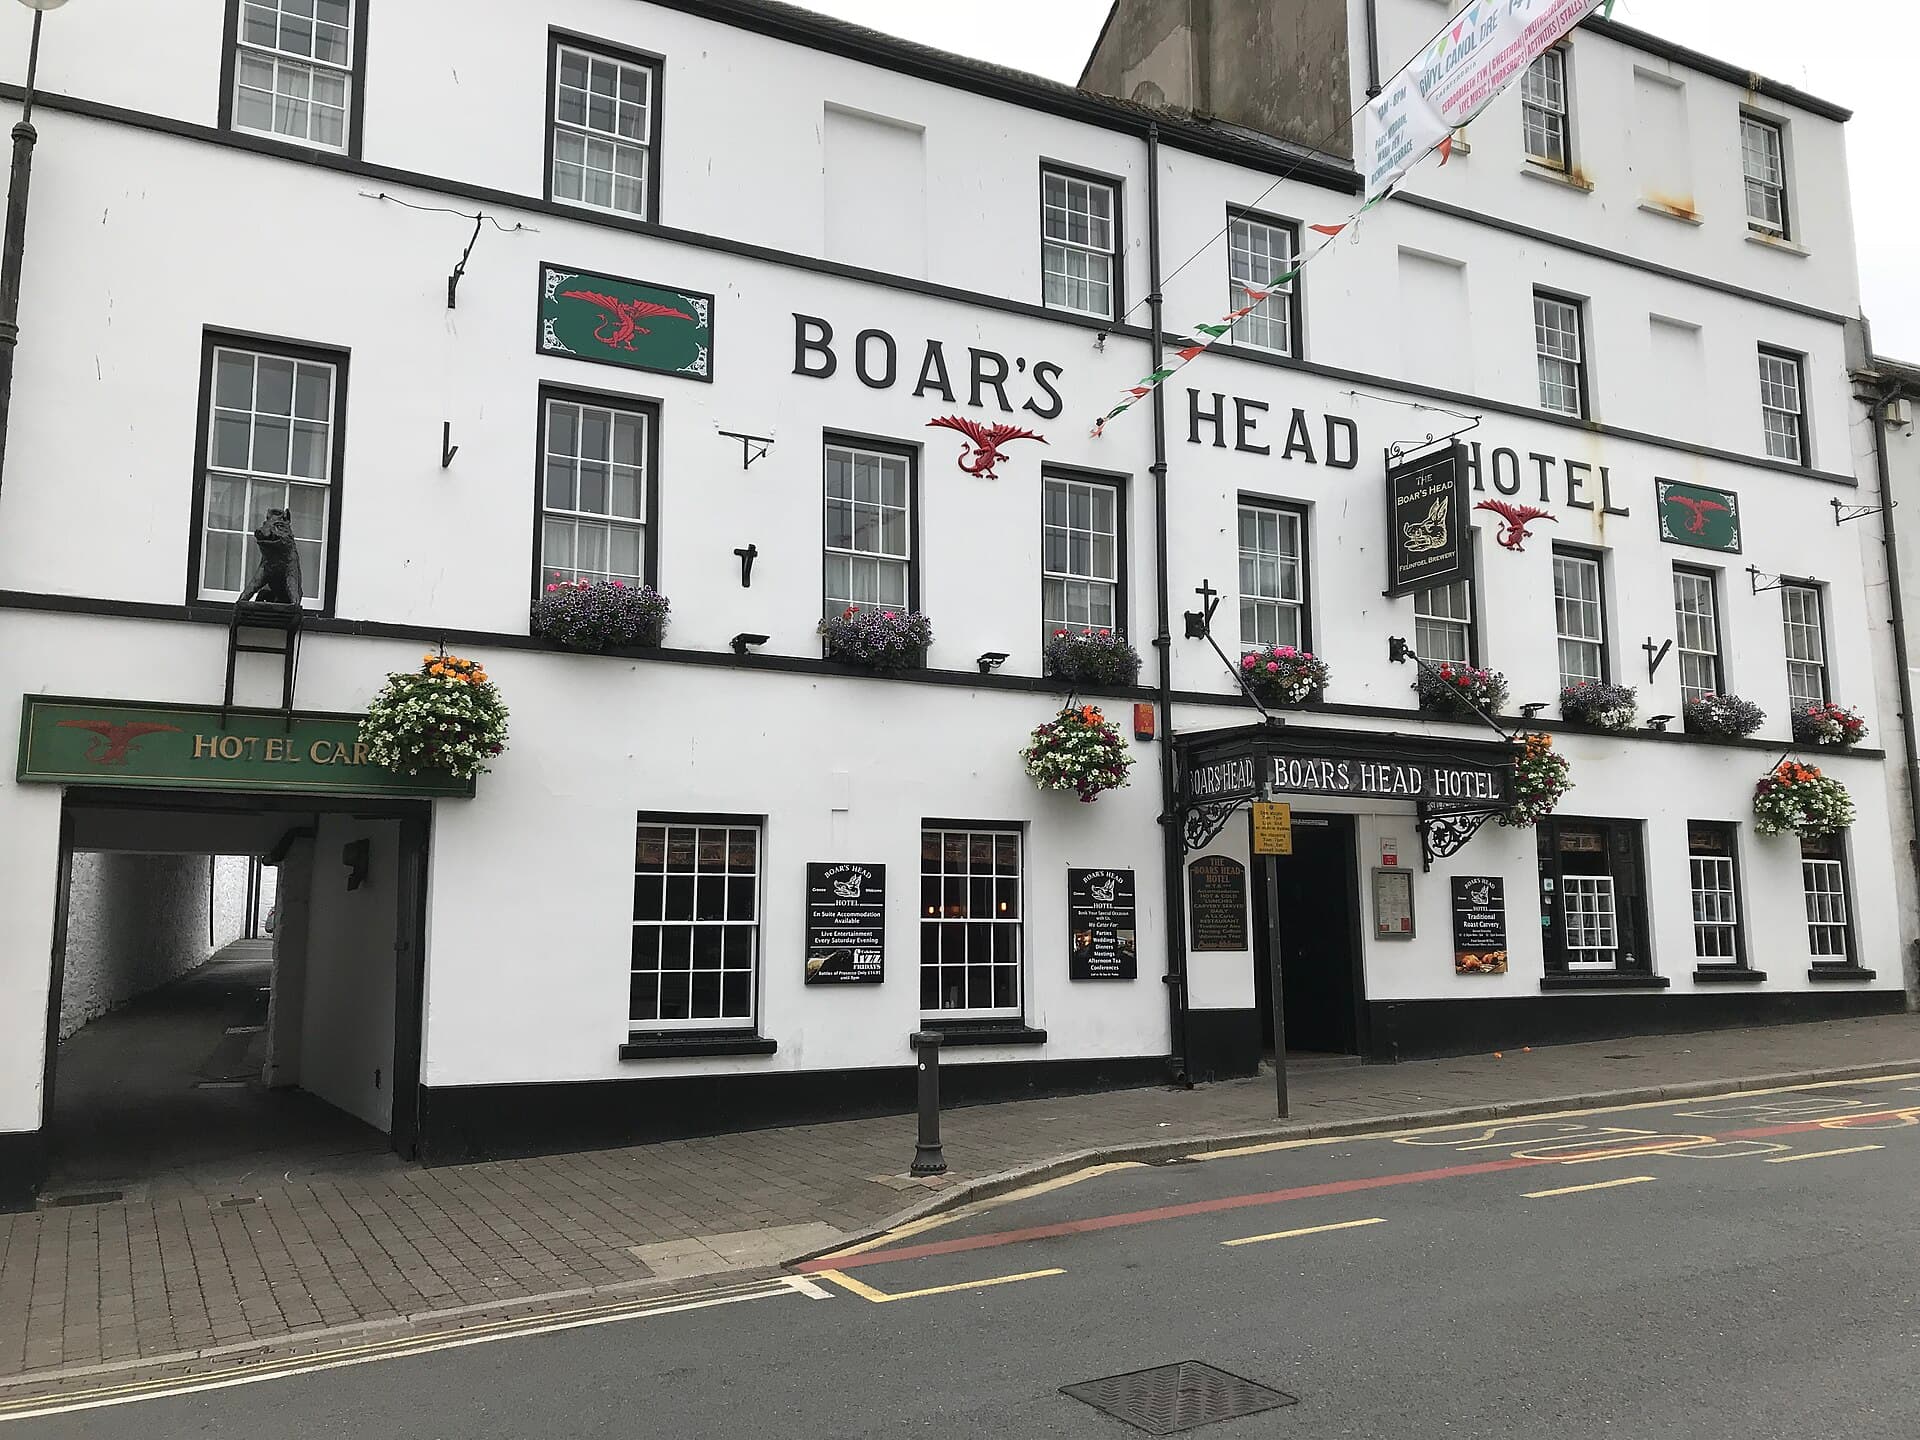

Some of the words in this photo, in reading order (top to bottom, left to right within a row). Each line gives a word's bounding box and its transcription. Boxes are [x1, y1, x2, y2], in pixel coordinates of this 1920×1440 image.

[1446, 32, 1477, 73] CANOL
[1480, 9, 1498, 43] DRE
[1459, 96, 1470, 114] LIVE
[1527, 24, 1557, 56] ACTIVITIES
[1560, 0, 1583, 25] STALLS
[792, 312, 1064, 420] BOAR'S
[1186, 387, 1359, 470] HEAD
[1397, 488, 1428, 506] BOAR'S
[1428, 480, 1454, 496] HEAD
[1416, 473, 1433, 487] THE
[193, 734, 301, 764] HOTEL
[310, 740, 370, 766] CAR
[1223, 759, 1253, 790] HEAD
[1273, 757, 1350, 790] BOARS
[1360, 758, 1423, 795] HEAD
[1433, 768, 1500, 800] HOTEL
[824, 865, 849, 878] BOAR'S
[852, 865, 872, 879] HEAD
[1083, 871, 1105, 884] BOAR'S
[1106, 871, 1124, 884] HEAD
[1479, 921, 1499, 929] Carvery
[831, 937, 856, 945] Saturday
